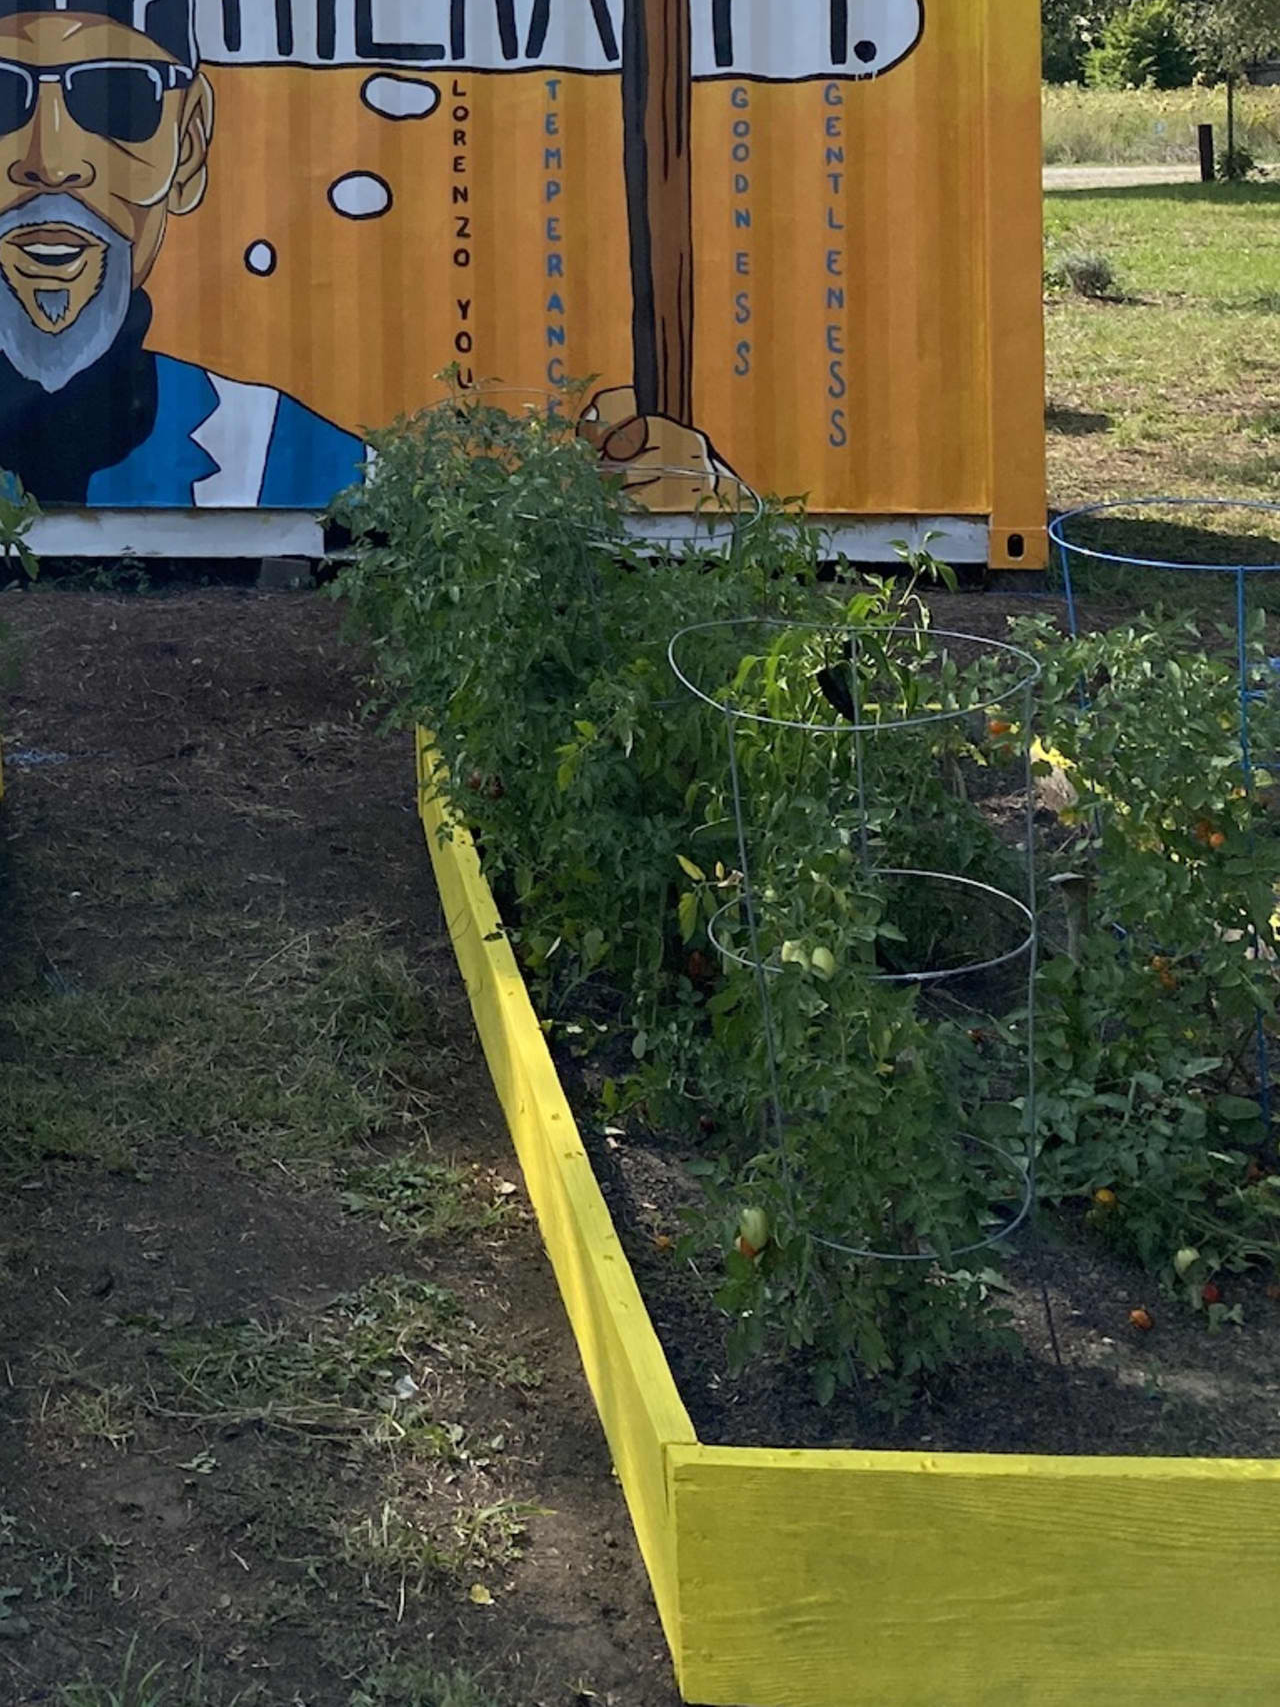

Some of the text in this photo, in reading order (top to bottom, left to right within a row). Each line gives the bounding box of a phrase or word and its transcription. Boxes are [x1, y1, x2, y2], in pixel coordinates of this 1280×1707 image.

[451, 80, 473, 269] LORENZO
[730, 88, 753, 378] GOODNESS
[825, 83, 848, 448] GENTLENESS
